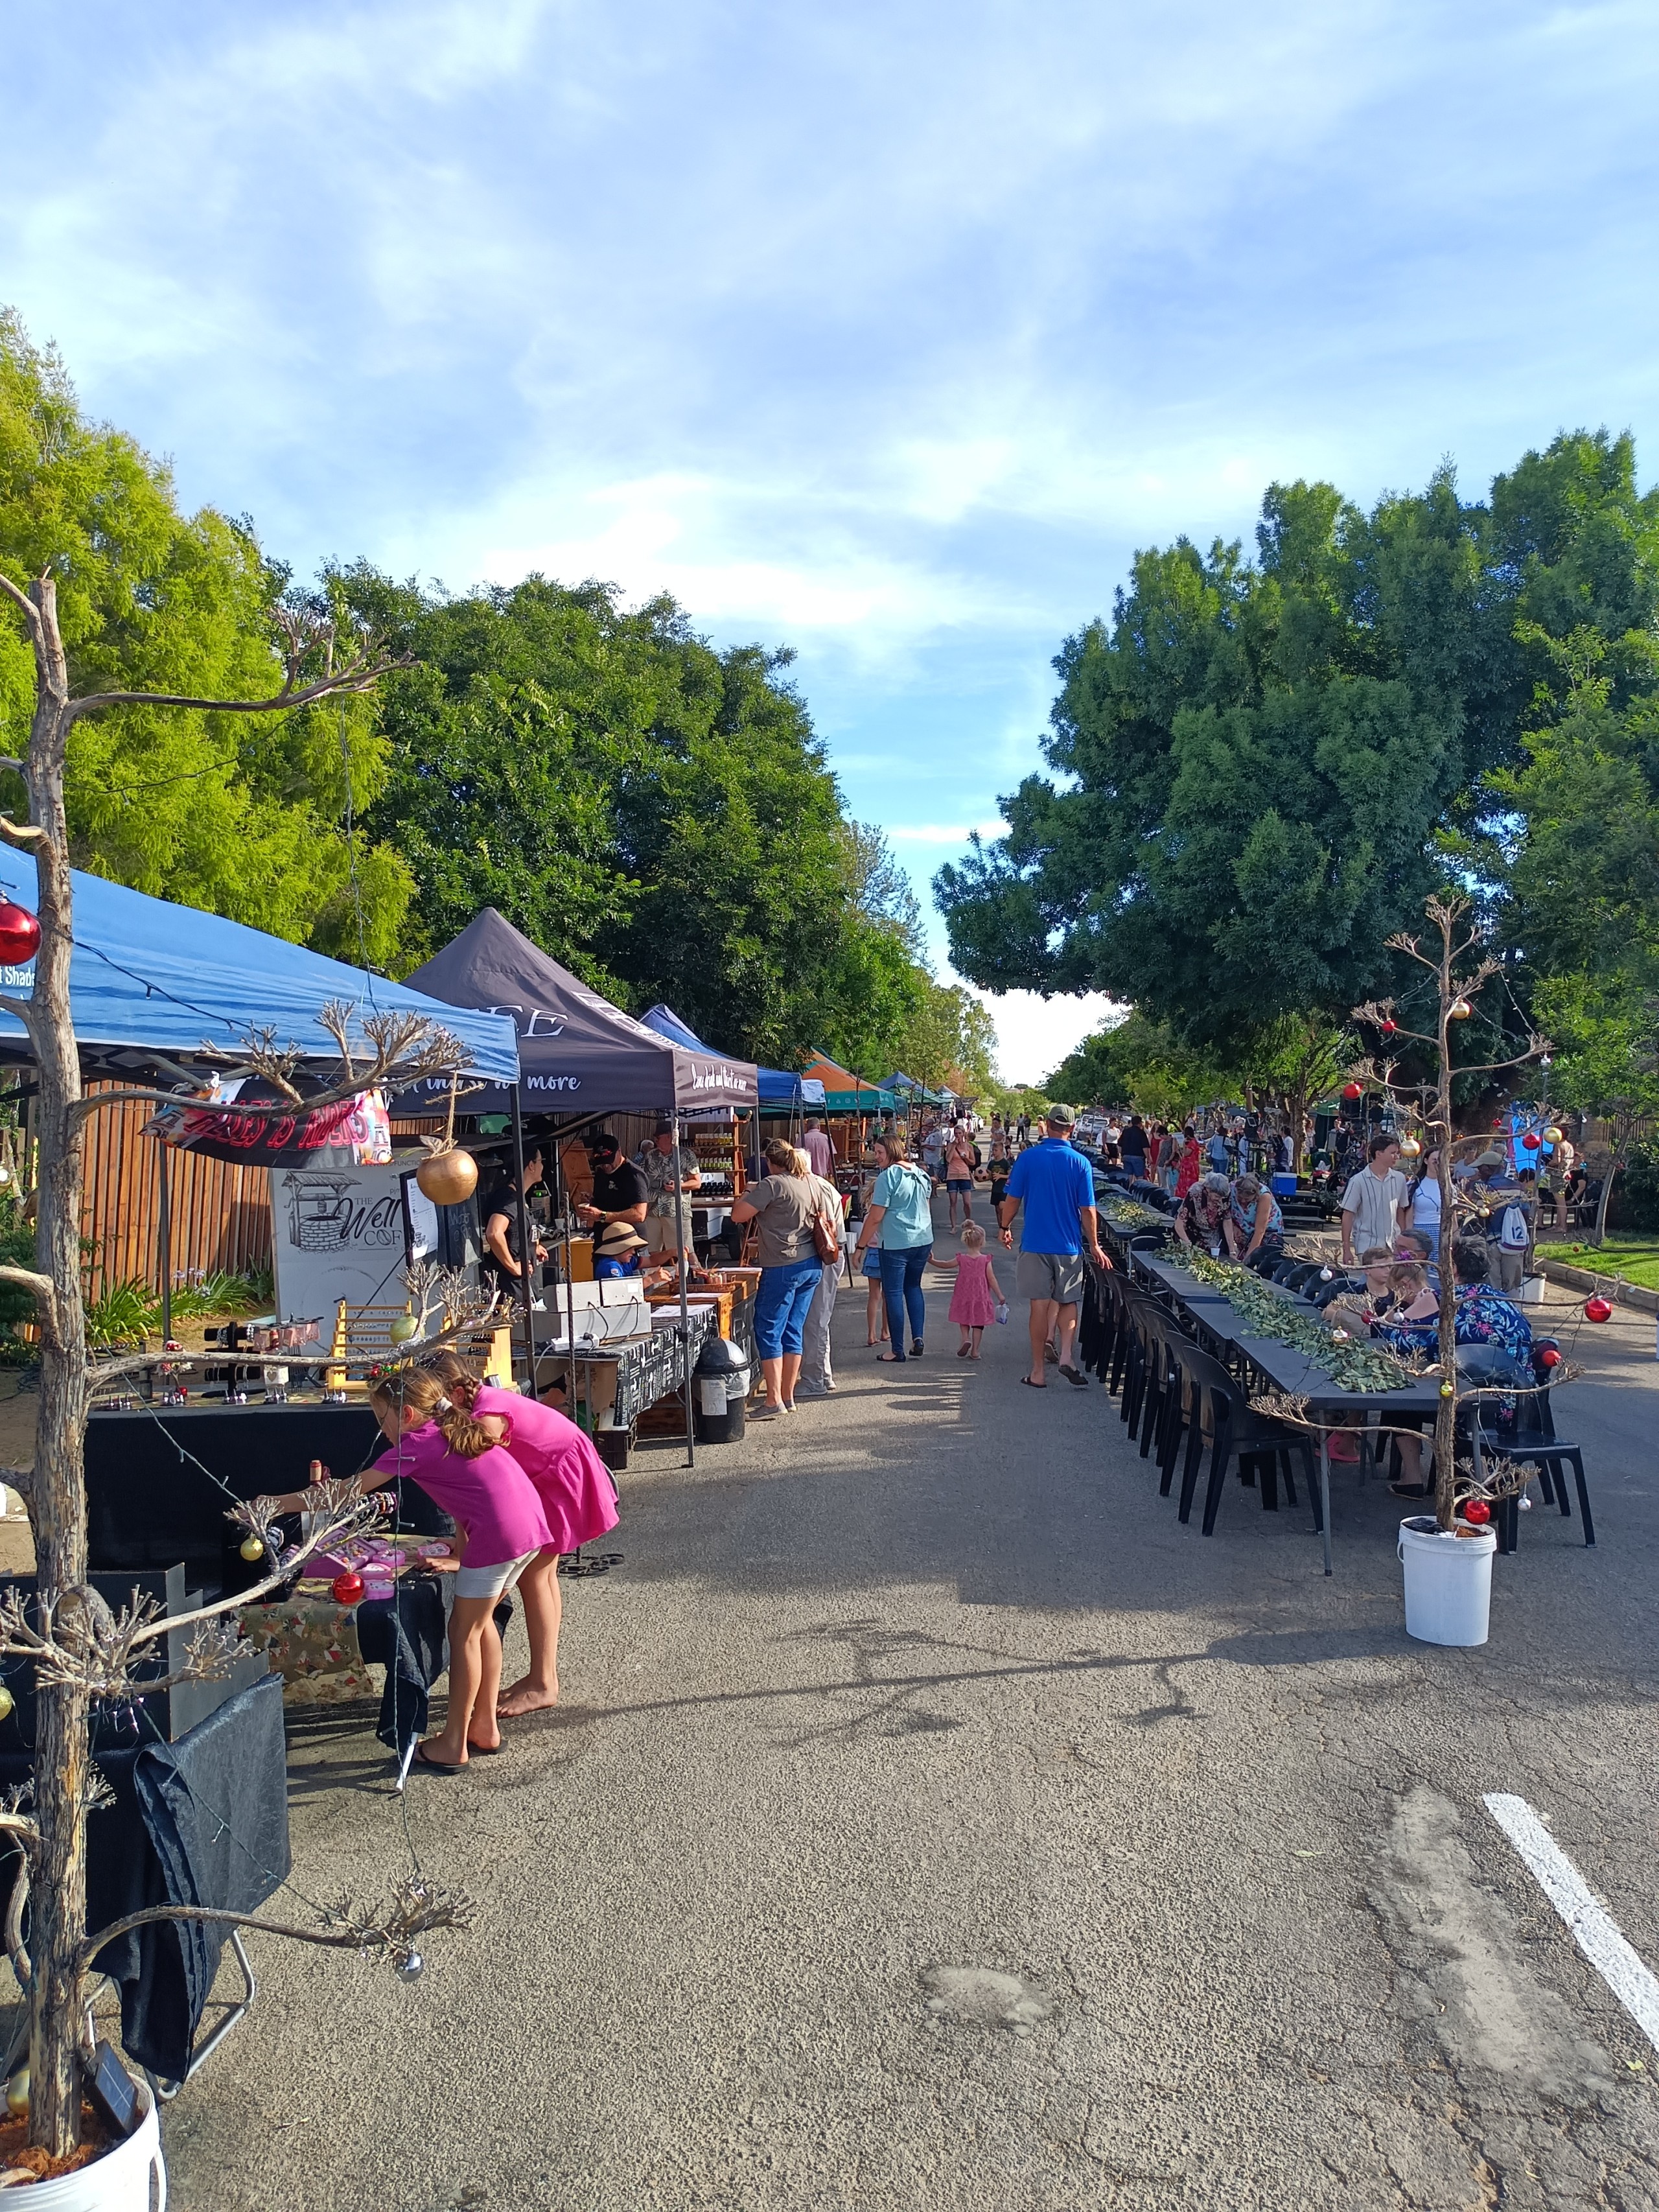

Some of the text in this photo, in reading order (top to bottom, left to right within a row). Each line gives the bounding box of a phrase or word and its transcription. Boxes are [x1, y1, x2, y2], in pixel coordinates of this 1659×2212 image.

[528, 1075, 581, 1091] more
[331, 1196, 402, 1239] Well
[1512, 1226, 1524, 1239] 12
